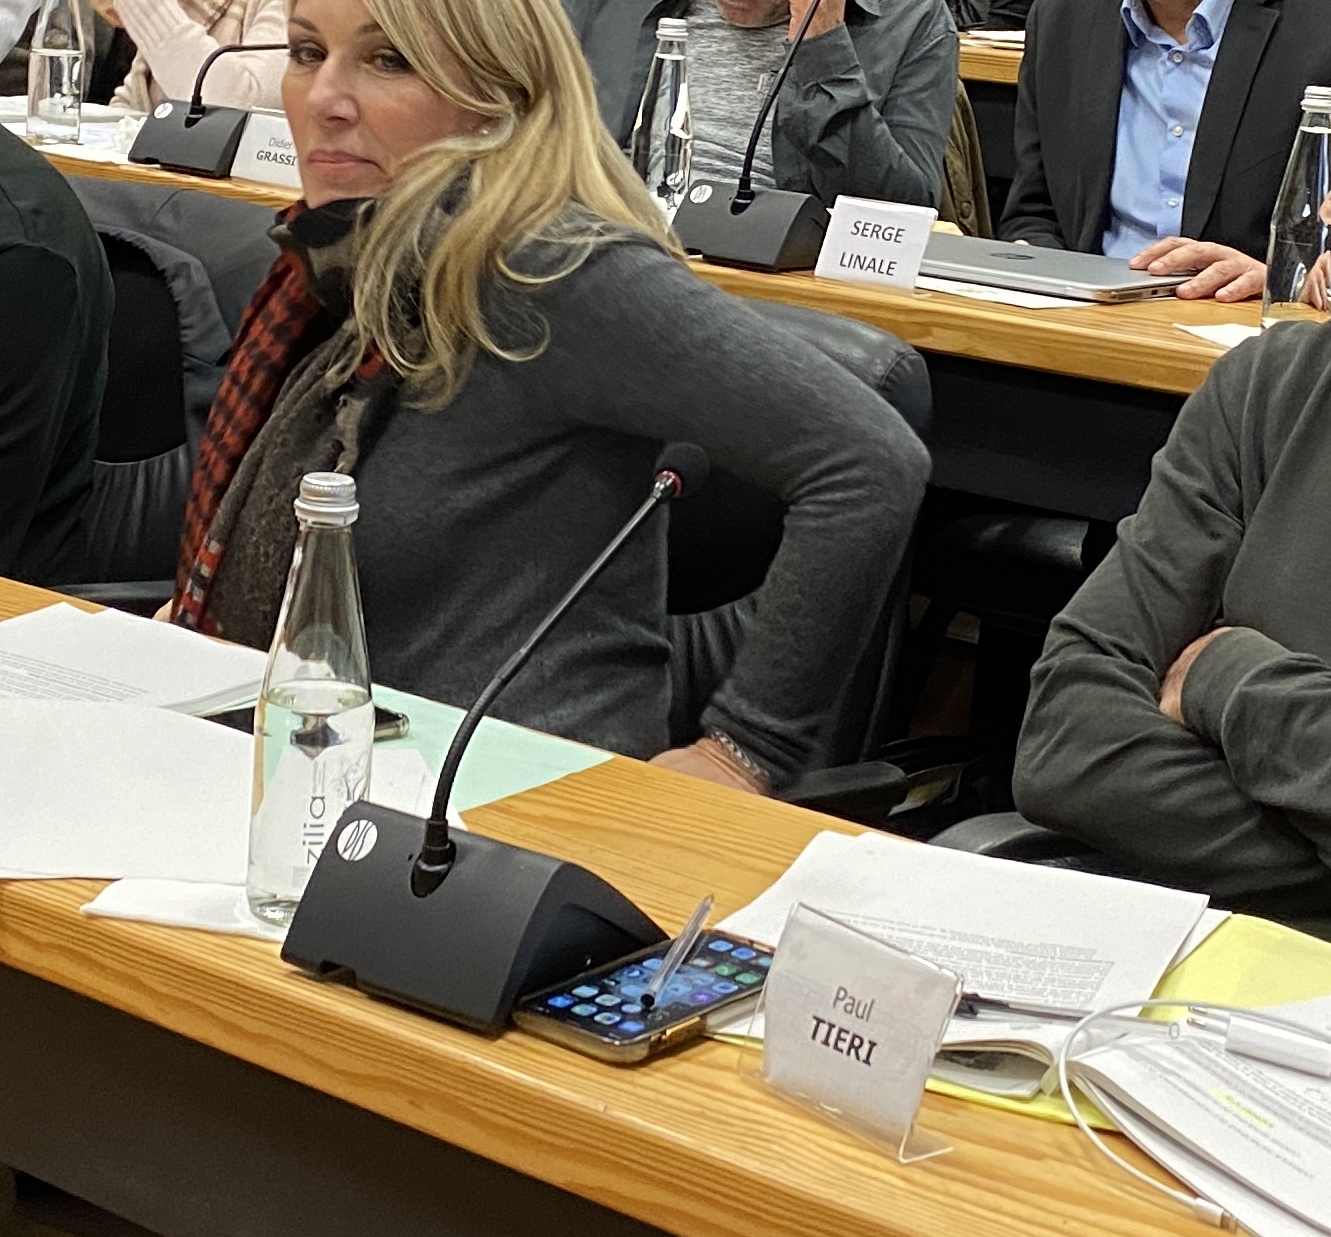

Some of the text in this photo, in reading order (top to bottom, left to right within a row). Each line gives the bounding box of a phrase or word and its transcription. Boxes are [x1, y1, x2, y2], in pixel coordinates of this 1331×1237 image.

[256, 149, 298, 167] GRASSI
[850, 220, 905, 243] SERGE
[839, 251, 898, 276] LINALE
[302, 795, 326, 864] zilia
[832, 985, 876, 1023] Paul
[811, 1015, 878, 1066] TIERI
